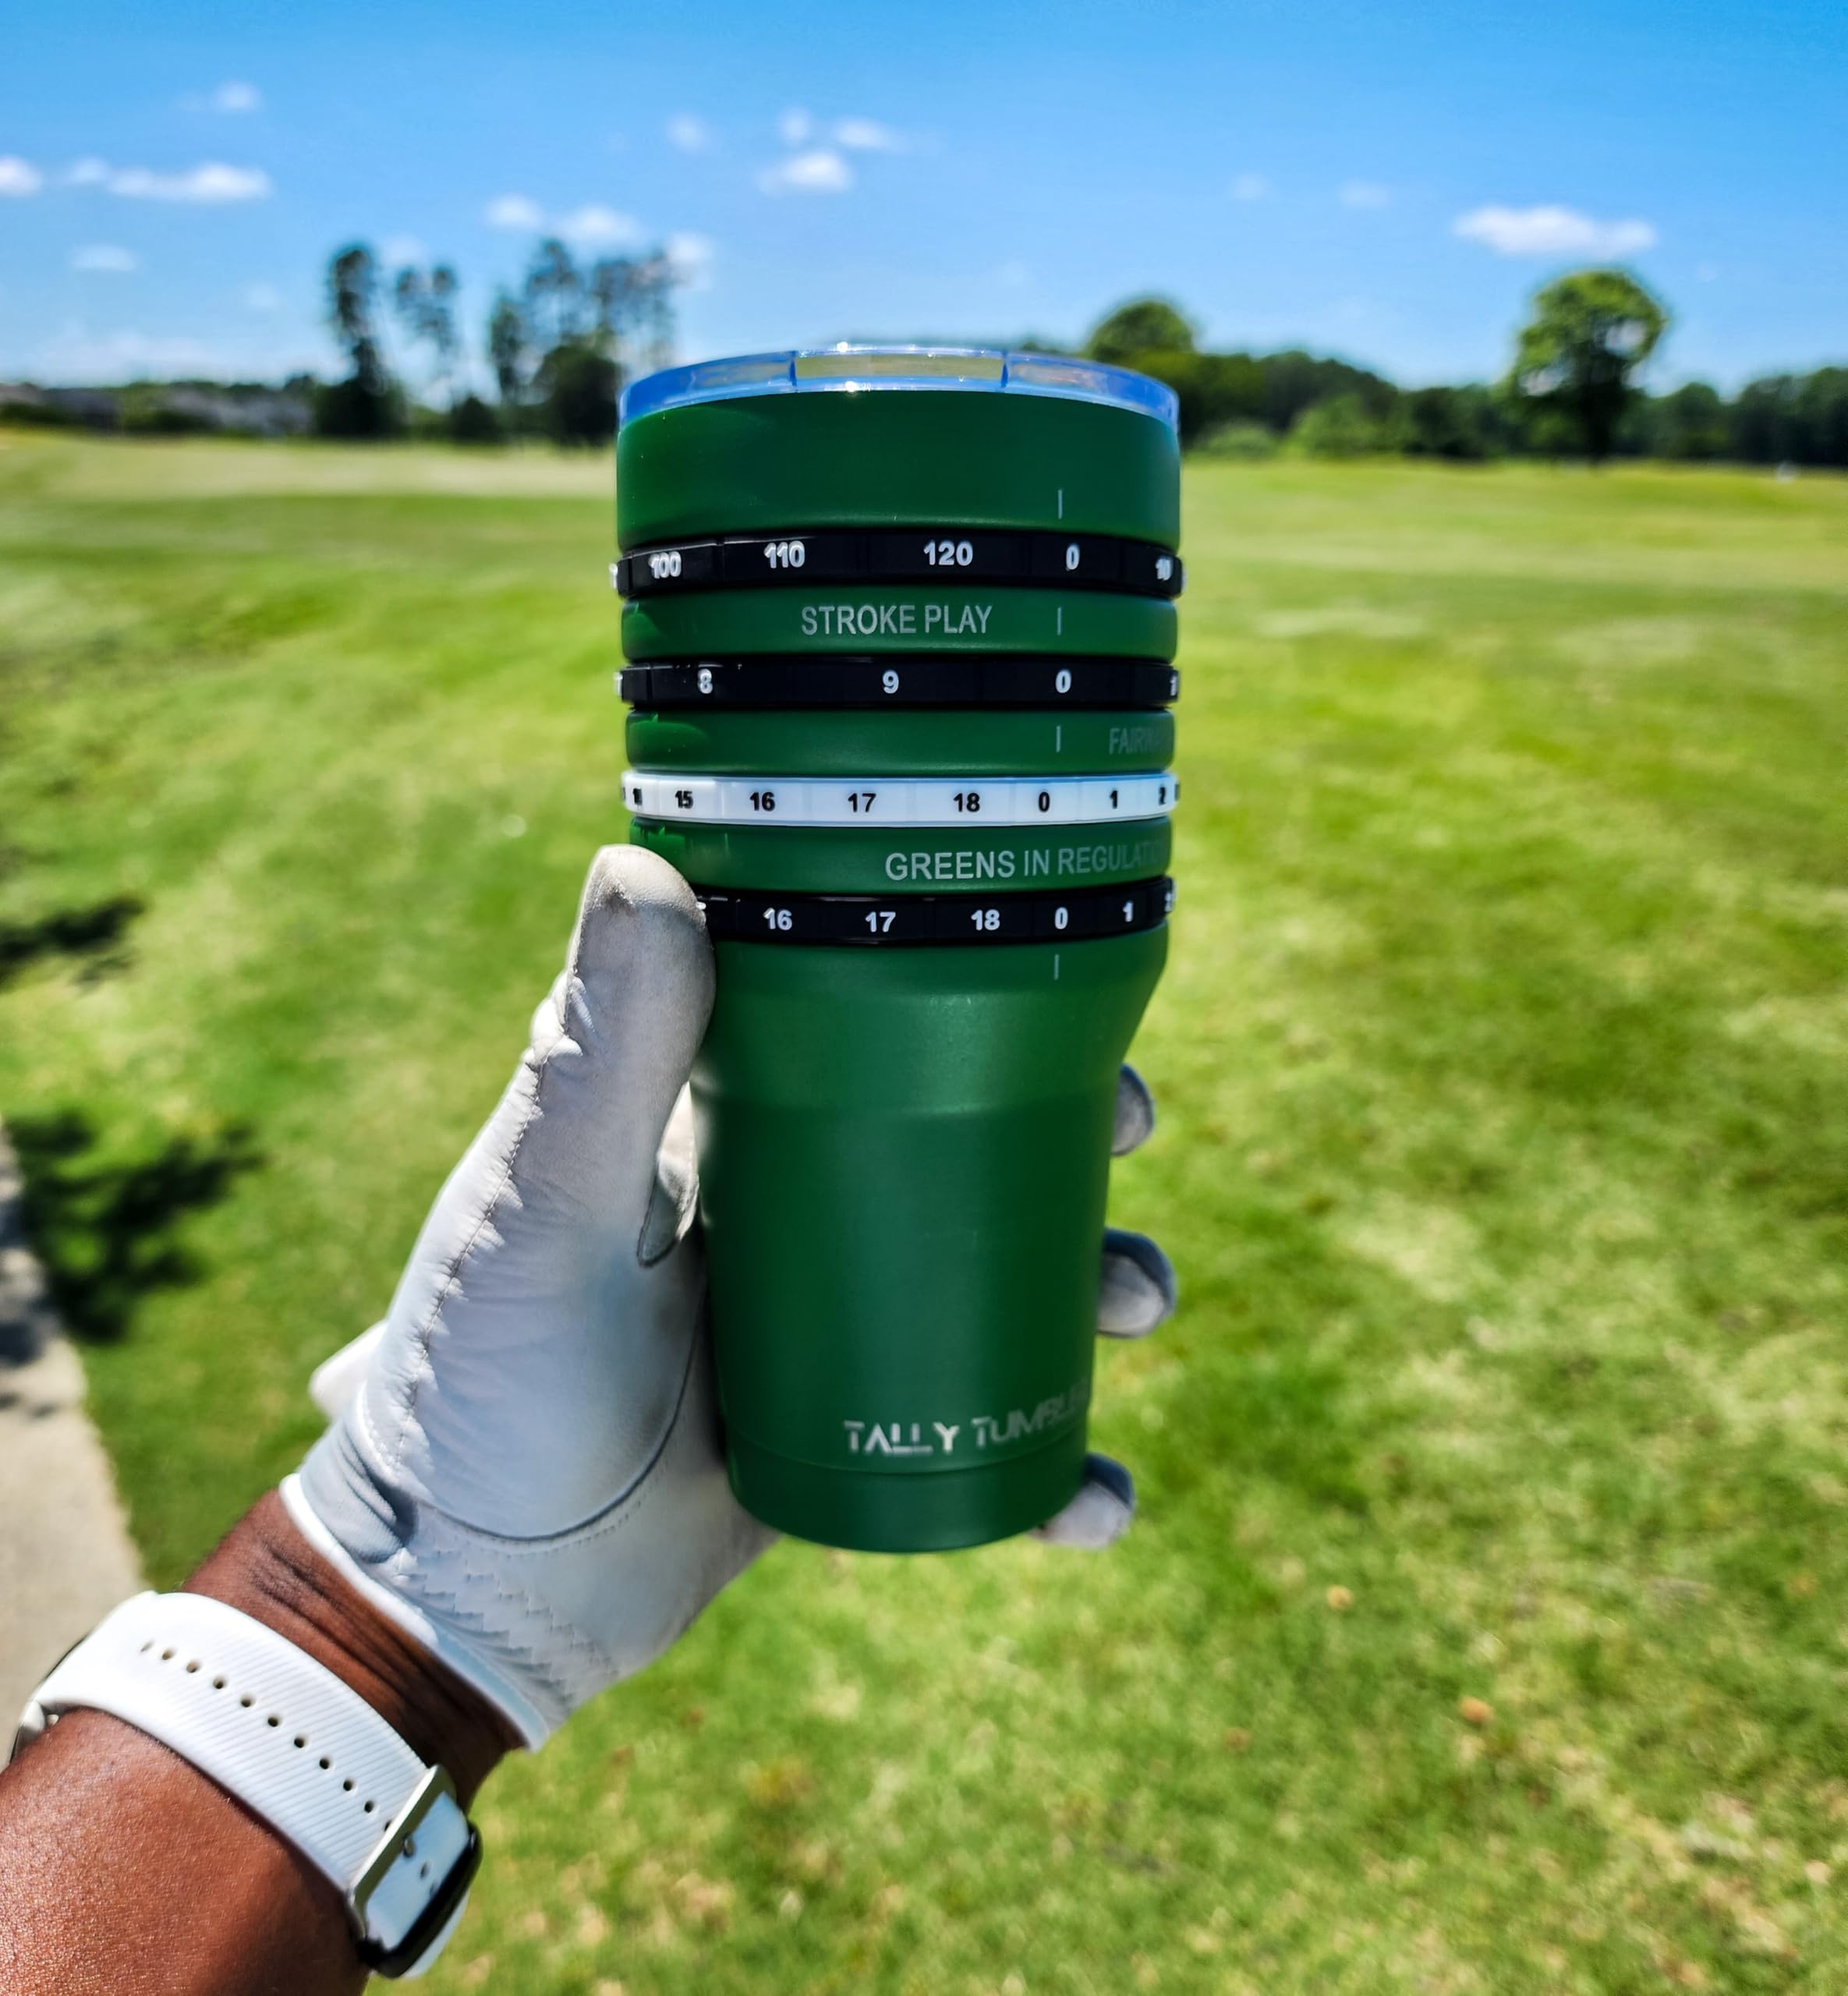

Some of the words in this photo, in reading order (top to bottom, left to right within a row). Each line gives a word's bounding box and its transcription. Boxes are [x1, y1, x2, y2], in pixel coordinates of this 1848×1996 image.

[649, 551, 681, 579] 100
[764, 540, 805, 568] 110
[923, 542, 974, 566] 120
[1066, 544, 1080, 570] 0
[802, 604, 917, 635] STROKE
[925, 605, 993, 634] PLAY
[698, 669, 713, 694] 8
[883, 670, 900, 694] 9
[1056, 670, 1072, 693] 0
[675, 790, 694, 809] 15
[749, 791, 776, 812] 16
[848, 793, 876, 812] 17
[953, 792, 980, 813] 18
[1038, 791, 1050, 812] 0
[1110, 790, 1118, 809] 1
[885, 850, 1015, 881] GREENS
[1024, 849, 1050, 876] IN
[763, 908, 793, 930] 16
[865, 911, 896, 933] 17
[971, 909, 1000, 931] 18
[1054, 907, 1068, 929] 0
[1122, 901, 1134, 922] 1
[844, 1421, 959, 1454] TALLY
